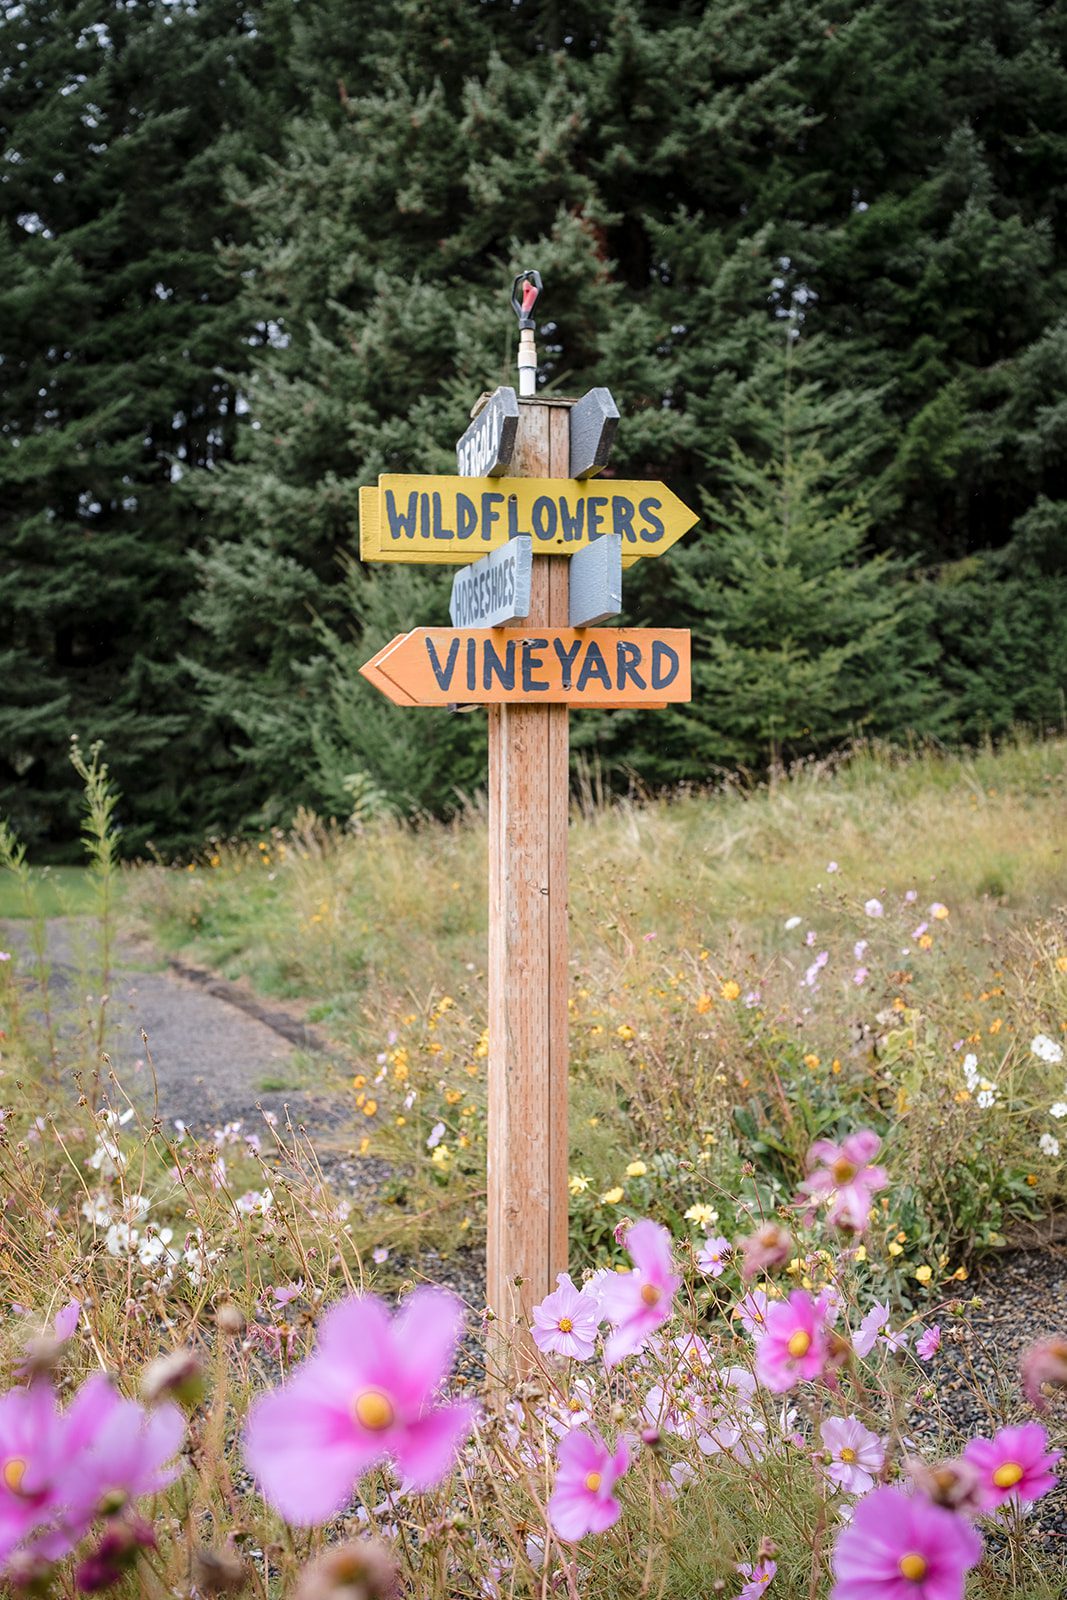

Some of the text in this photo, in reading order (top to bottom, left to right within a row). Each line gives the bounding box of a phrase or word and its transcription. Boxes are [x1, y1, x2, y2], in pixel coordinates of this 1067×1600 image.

[384, 489, 665, 543] WILDFLOWERS
[454, 556, 516, 628] HORSESHOES
[425, 637, 680, 692] VINEYARD
